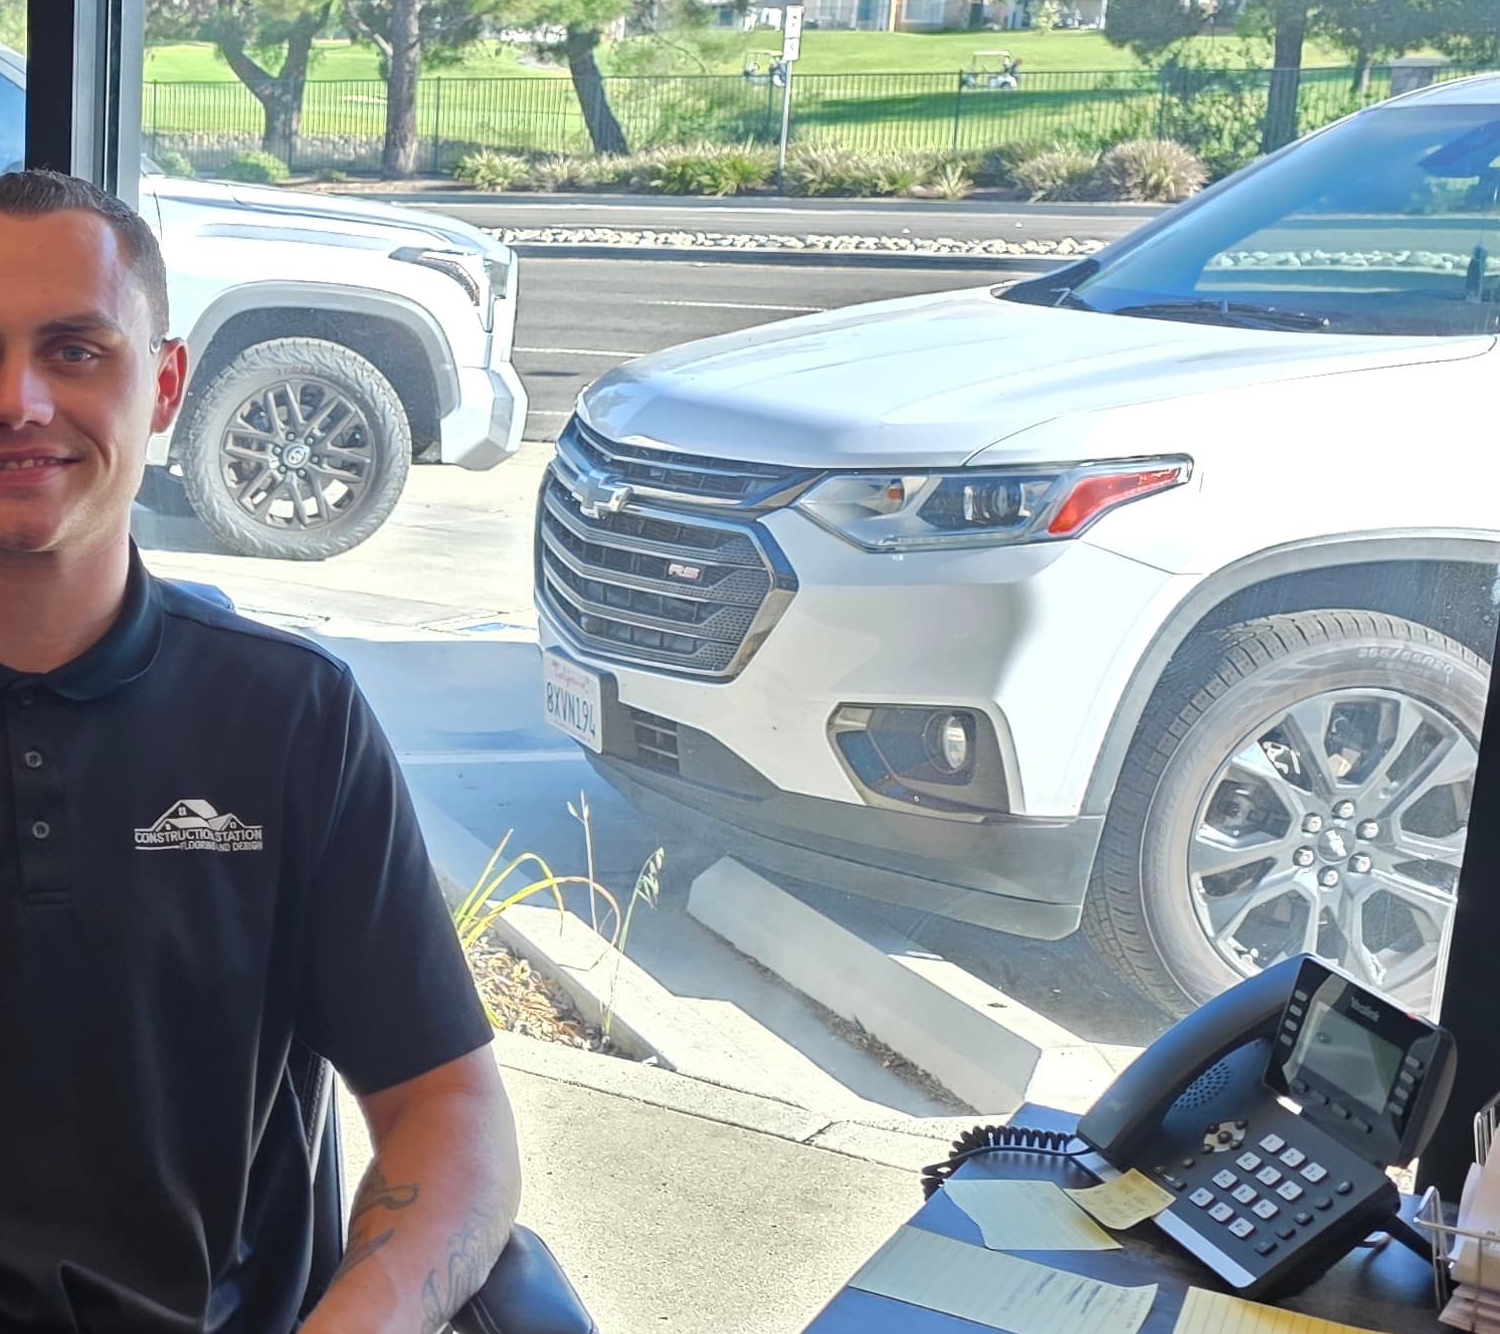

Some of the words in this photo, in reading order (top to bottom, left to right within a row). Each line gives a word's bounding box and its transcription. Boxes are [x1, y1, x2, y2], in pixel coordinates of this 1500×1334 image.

[668, 563, 701, 580] RS
[546, 680, 596, 738] 8XVN194
[214, 828, 263, 843] STATION
